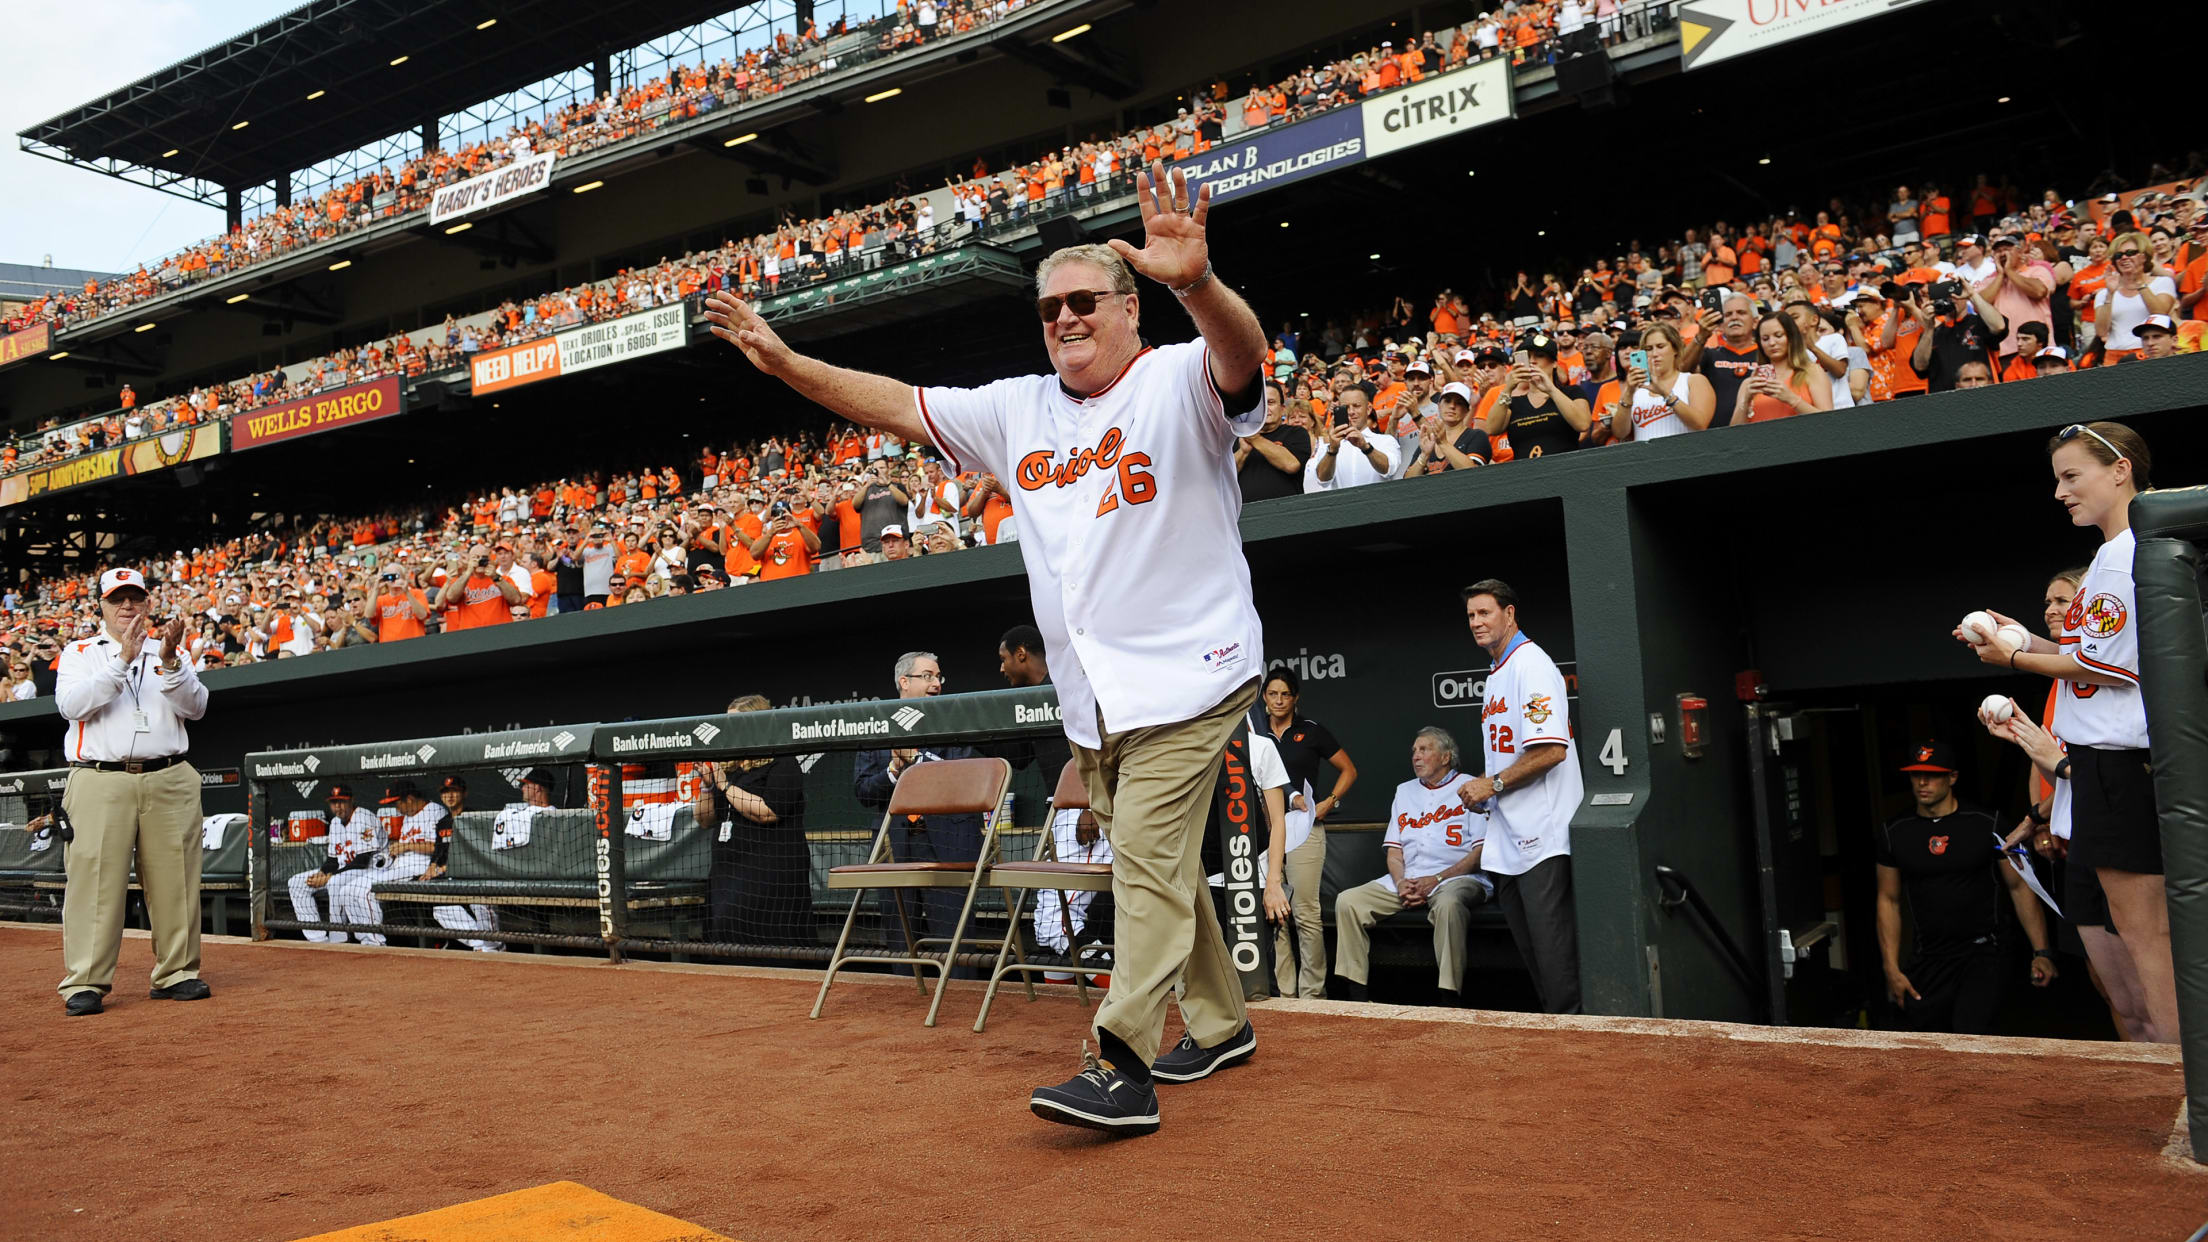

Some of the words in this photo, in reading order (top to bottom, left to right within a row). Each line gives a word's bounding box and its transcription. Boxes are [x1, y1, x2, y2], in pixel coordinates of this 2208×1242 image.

[1183, 153, 1239, 180] PLAN
[1243, 146, 1258, 169] B
[1208, 138, 1362, 198] TECHNOLOGIES
[436, 177, 492, 217] HARDY'S
[494, 159, 546, 199] HEROES
[563, 338, 578, 351] TEXT
[581, 325, 617, 347] ORIOLES
[653, 309, 680, 329] ISSUE
[475, 347, 510, 387] NEED
[513, 342, 556, 378] HELP?
[569, 343, 613, 366] LOCATION
[248, 405, 311, 440] WELLS
[317, 388, 383, 423] FARGO
[48, 449, 120, 491] ANNIVERSARY
[1016, 427, 1127, 491] Oriol
[792, 720, 823, 739] Bank
[823, 719, 836, 737] of
[837, 717, 889, 736] America
[1015, 702, 1055, 724] Bank
[484, 742, 505, 759] Bank
[505, 741, 516, 757] of
[514, 739, 550, 756] America
[613, 735, 638, 752] Bank
[638, 733, 649, 750] of
[649, 731, 692, 749] America
[1489, 723, 1515, 753] 22
[1599, 728, 1629, 775] 4
[256, 763, 272, 776] Bank
[279, 761, 304, 775] America
[361, 755, 379, 769] Bank
[379, 753, 386, 768] of
[386, 752, 415, 767] America
[1445, 824, 1462, 847] 5
